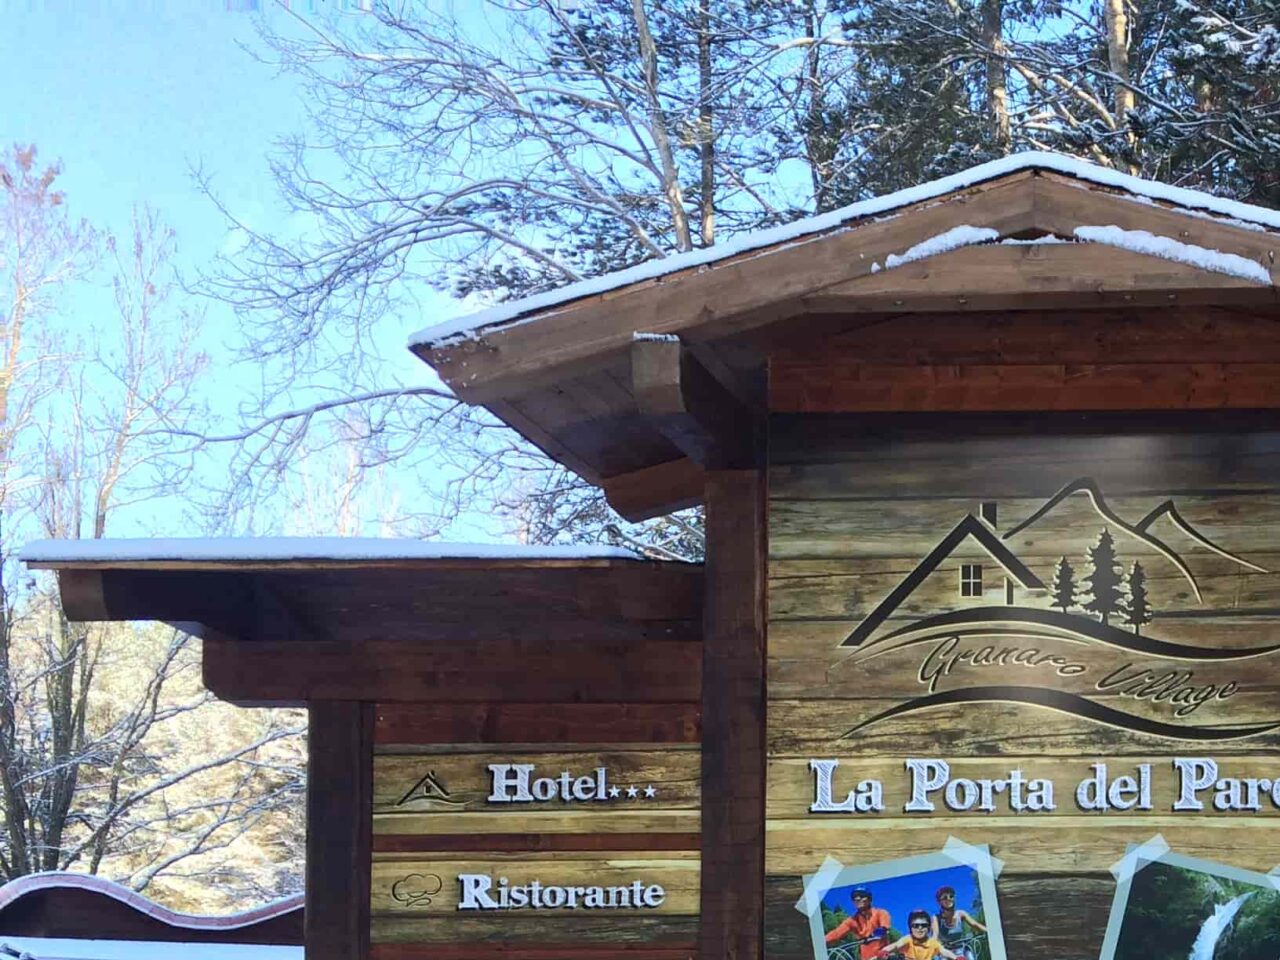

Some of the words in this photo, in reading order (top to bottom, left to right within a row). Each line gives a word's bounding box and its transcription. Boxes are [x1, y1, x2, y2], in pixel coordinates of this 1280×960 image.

[1095, 662, 1240, 718] Village
[809, 758, 885, 812] La
[905, 758, 1057, 812] Porta
[1075, 761, 1153, 811] del
[457, 873, 666, 910] Ristorante
